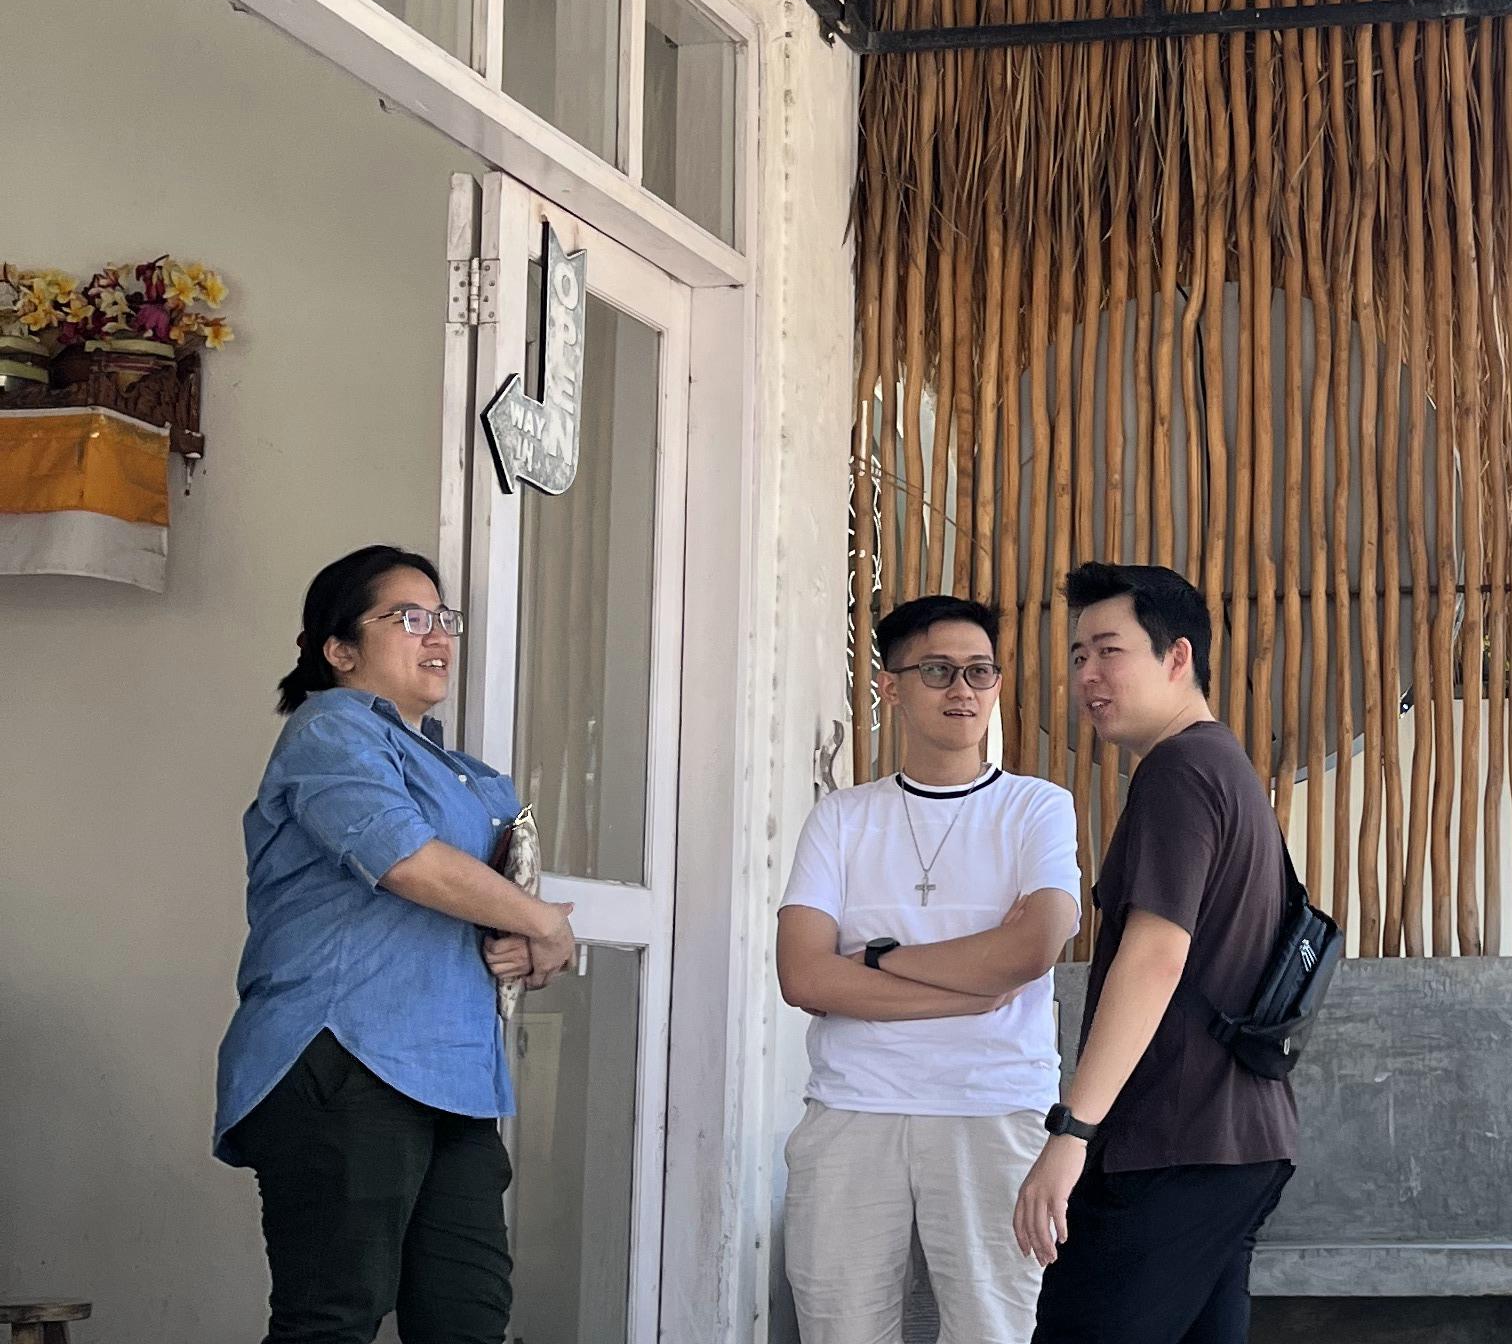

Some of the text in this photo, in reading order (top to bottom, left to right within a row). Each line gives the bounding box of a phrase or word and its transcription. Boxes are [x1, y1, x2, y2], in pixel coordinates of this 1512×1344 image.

[543, 261, 580, 466] OPEN
[510, 401, 546, 440] WAY
[514, 435, 534, 472] IN
